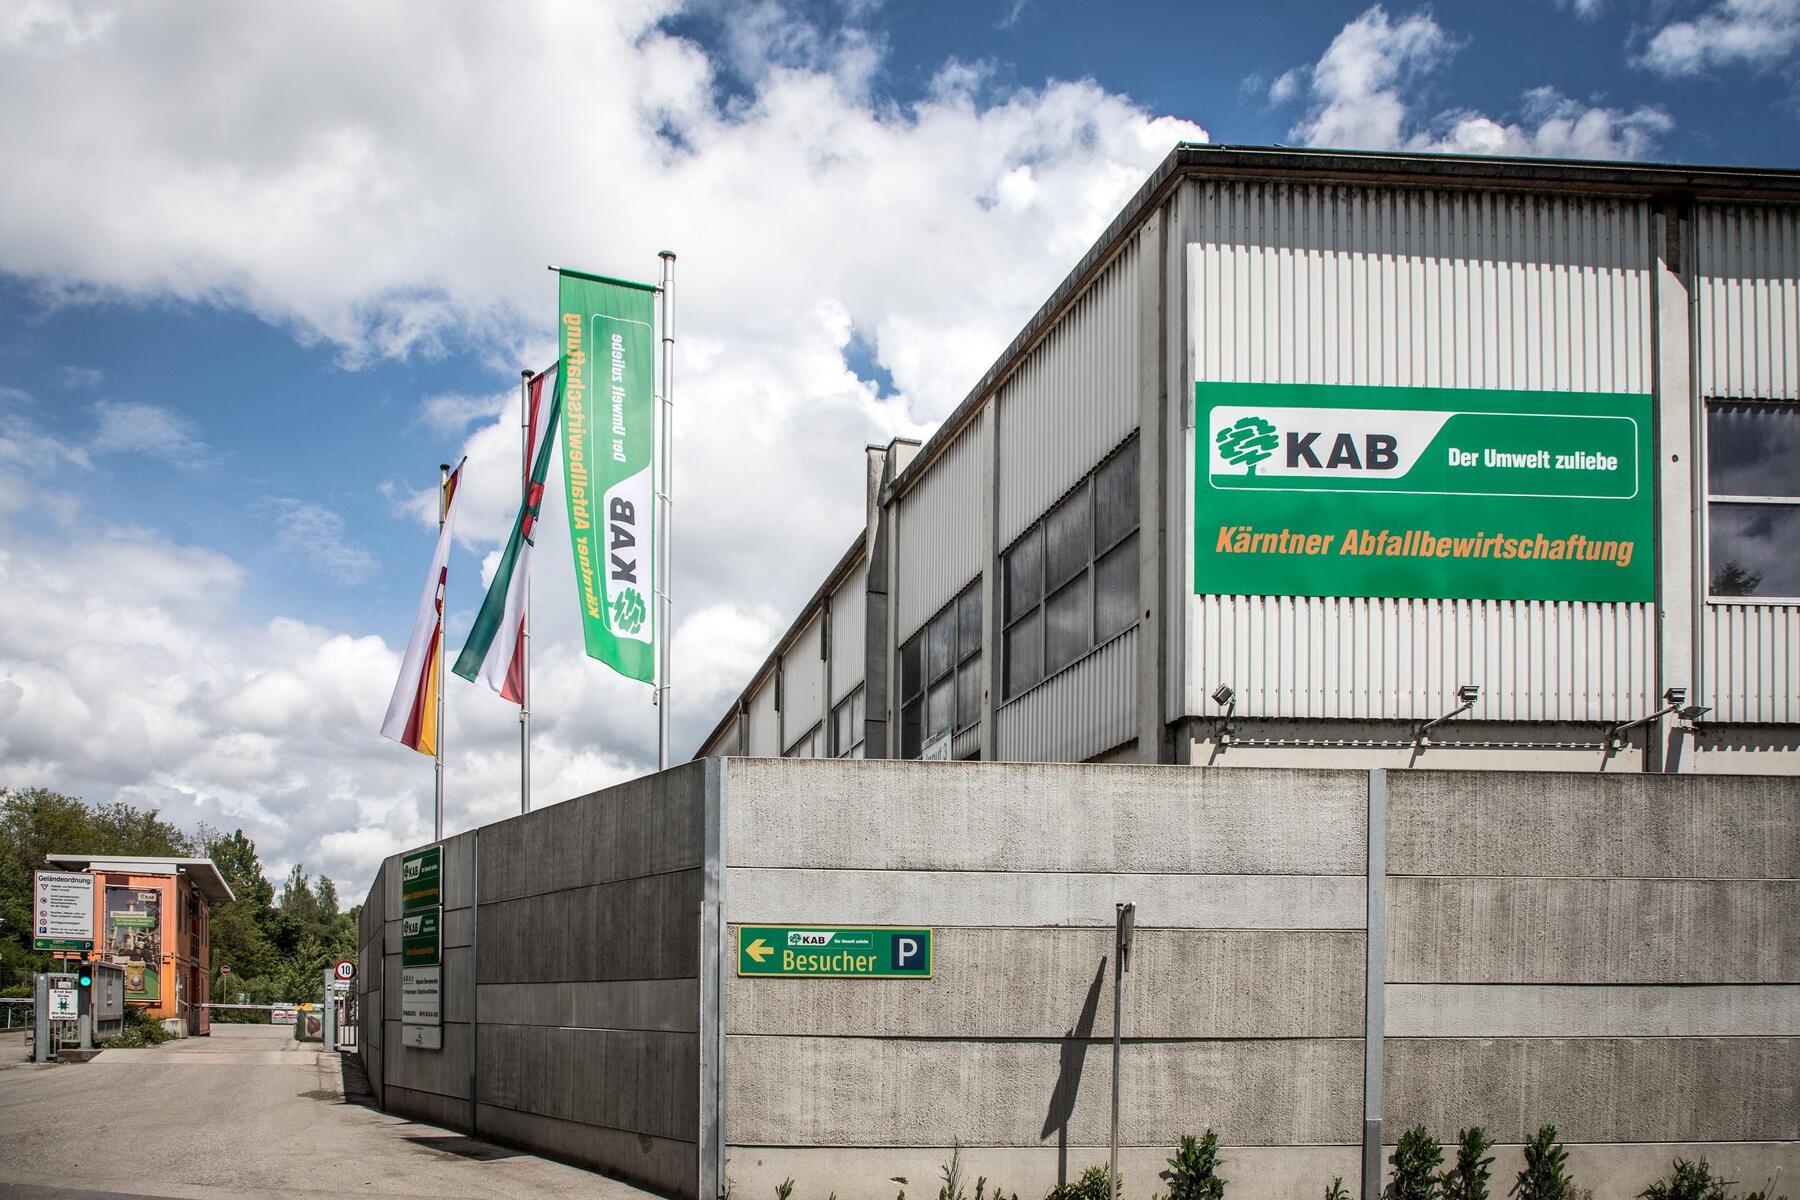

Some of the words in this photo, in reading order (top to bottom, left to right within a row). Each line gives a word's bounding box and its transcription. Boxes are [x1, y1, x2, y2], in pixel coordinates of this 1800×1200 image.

[1285, 431, 1399, 471] KAB
[1448, 447, 1479, 468] Der
[1484, 448, 1551, 470] Umwelt
[1555, 451, 1618, 472] zuliebe
[1215, 525, 1334, 556] Kärntner
[1340, 528, 1634, 567] Abfallbewirtschaftung
[38, 874, 93, 885] Geländeordnung:
[802, 936, 826, 945] KAB
[782, 949, 877, 972] Besucher
[898, 938, 918, 967] P
[341, 965, 351, 975] 10
